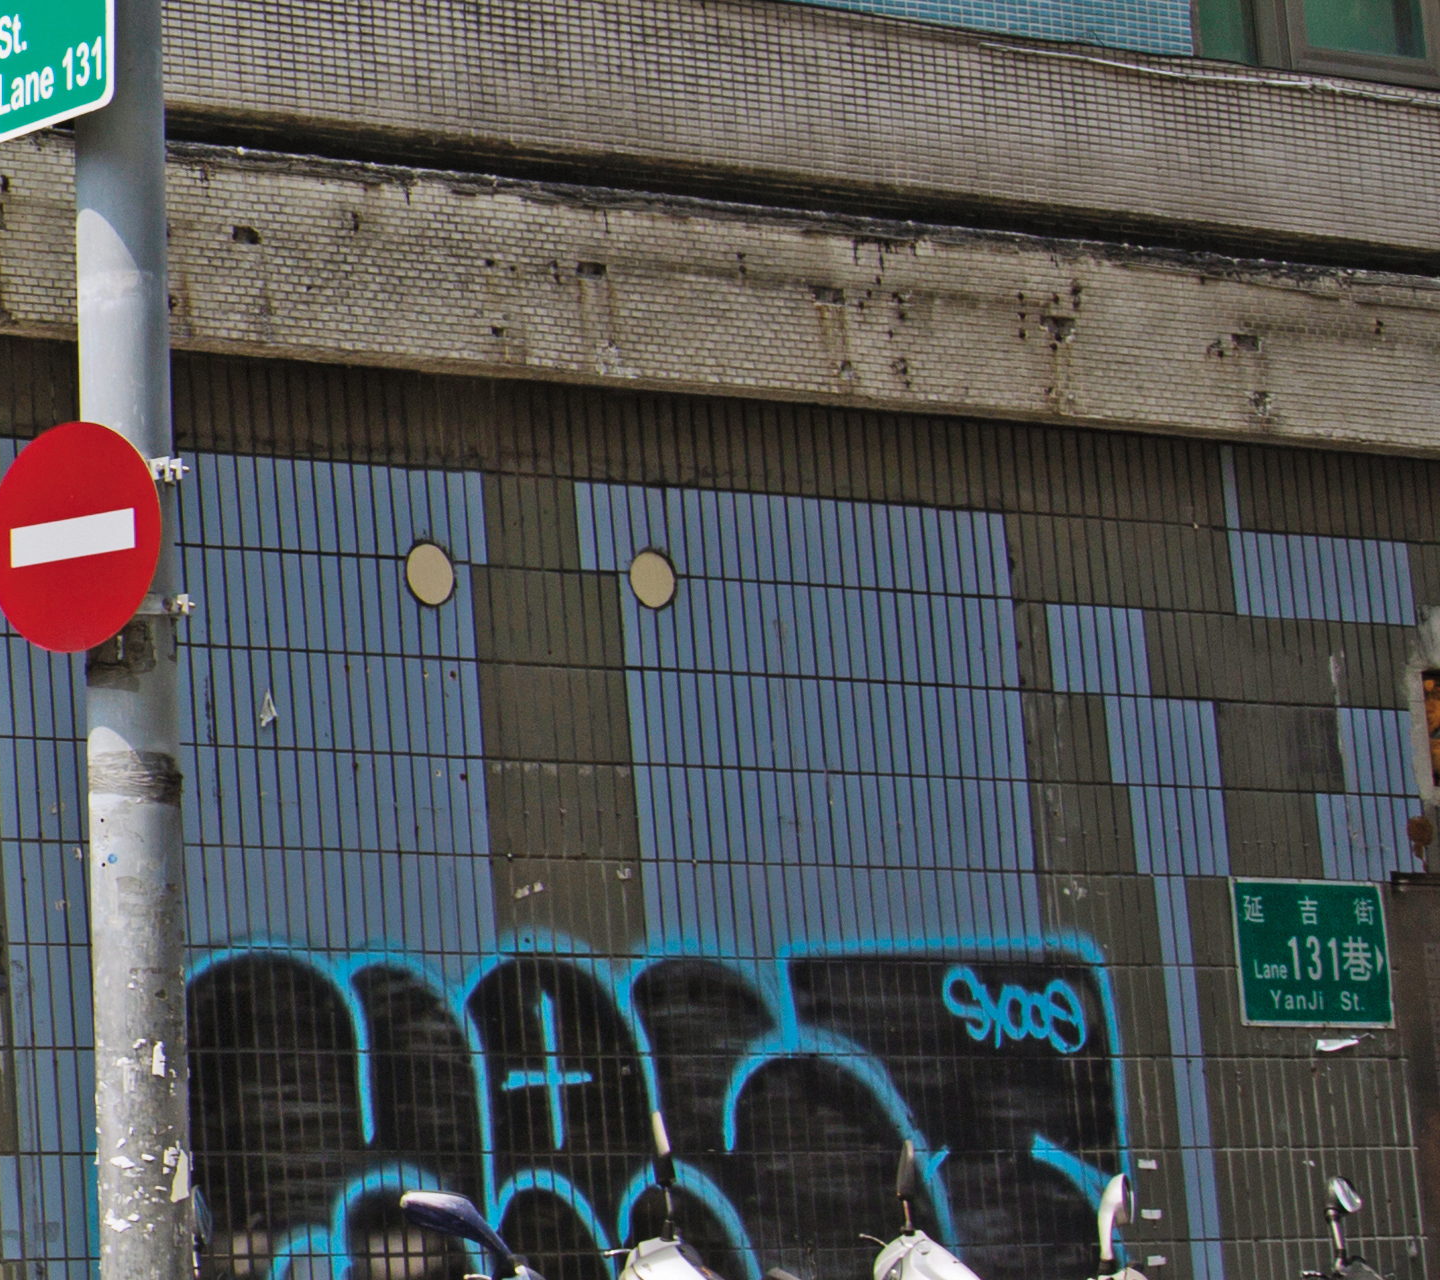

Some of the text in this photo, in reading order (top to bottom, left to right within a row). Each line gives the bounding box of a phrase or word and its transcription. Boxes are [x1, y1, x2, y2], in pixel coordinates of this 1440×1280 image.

[62, 36, 102, 90] 131
[1242, 895, 1375, 926] 延吉街
[1253, 935, 1373, 982] Lane 131巷
[1270, 989, 1366, 1011] YanJi St.
